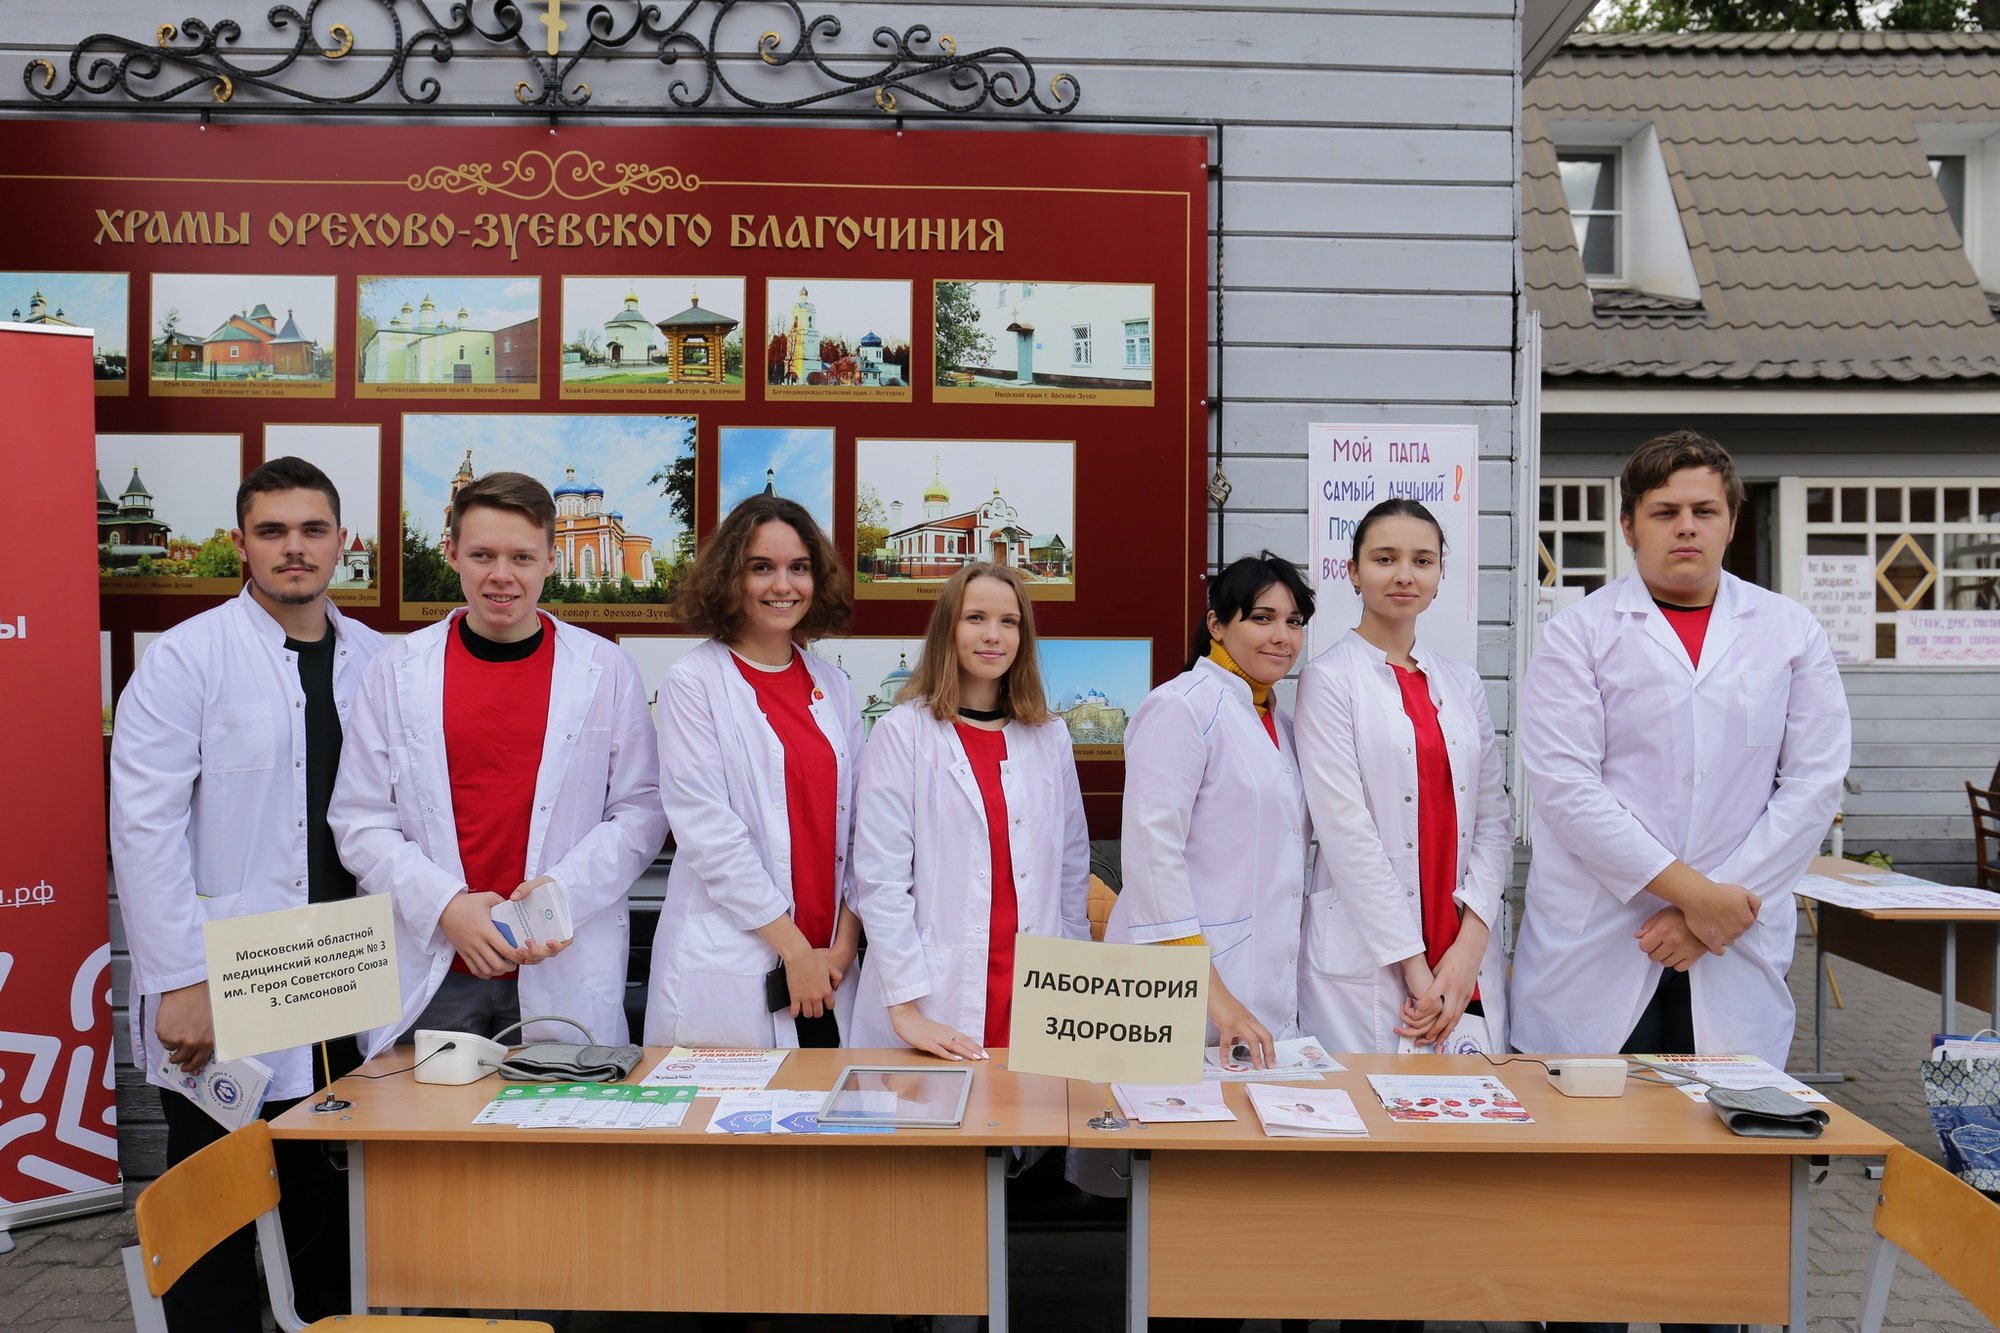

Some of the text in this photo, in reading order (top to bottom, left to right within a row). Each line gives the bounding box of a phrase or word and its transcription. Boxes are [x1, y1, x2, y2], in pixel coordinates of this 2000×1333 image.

[94, 209, 1006, 261] ХРАМЫ ОРЕХОВО-ЗУЕВСКОГО БЛАГОЧИНИЯ
[563, 609, 590, 618] собор
[235, 927, 374, 962] Московский областной
[222, 940, 386, 982] медицинский колледж № 3
[224, 958, 388, 999] им. Героя Советского Союза
[284, 980, 357, 1004] Самсоновой
[1023, 970, 1198, 999] ЛАБОРАТОРИЯ
[1045, 1016, 1173, 1044] ЗДОРОВЬЯ
